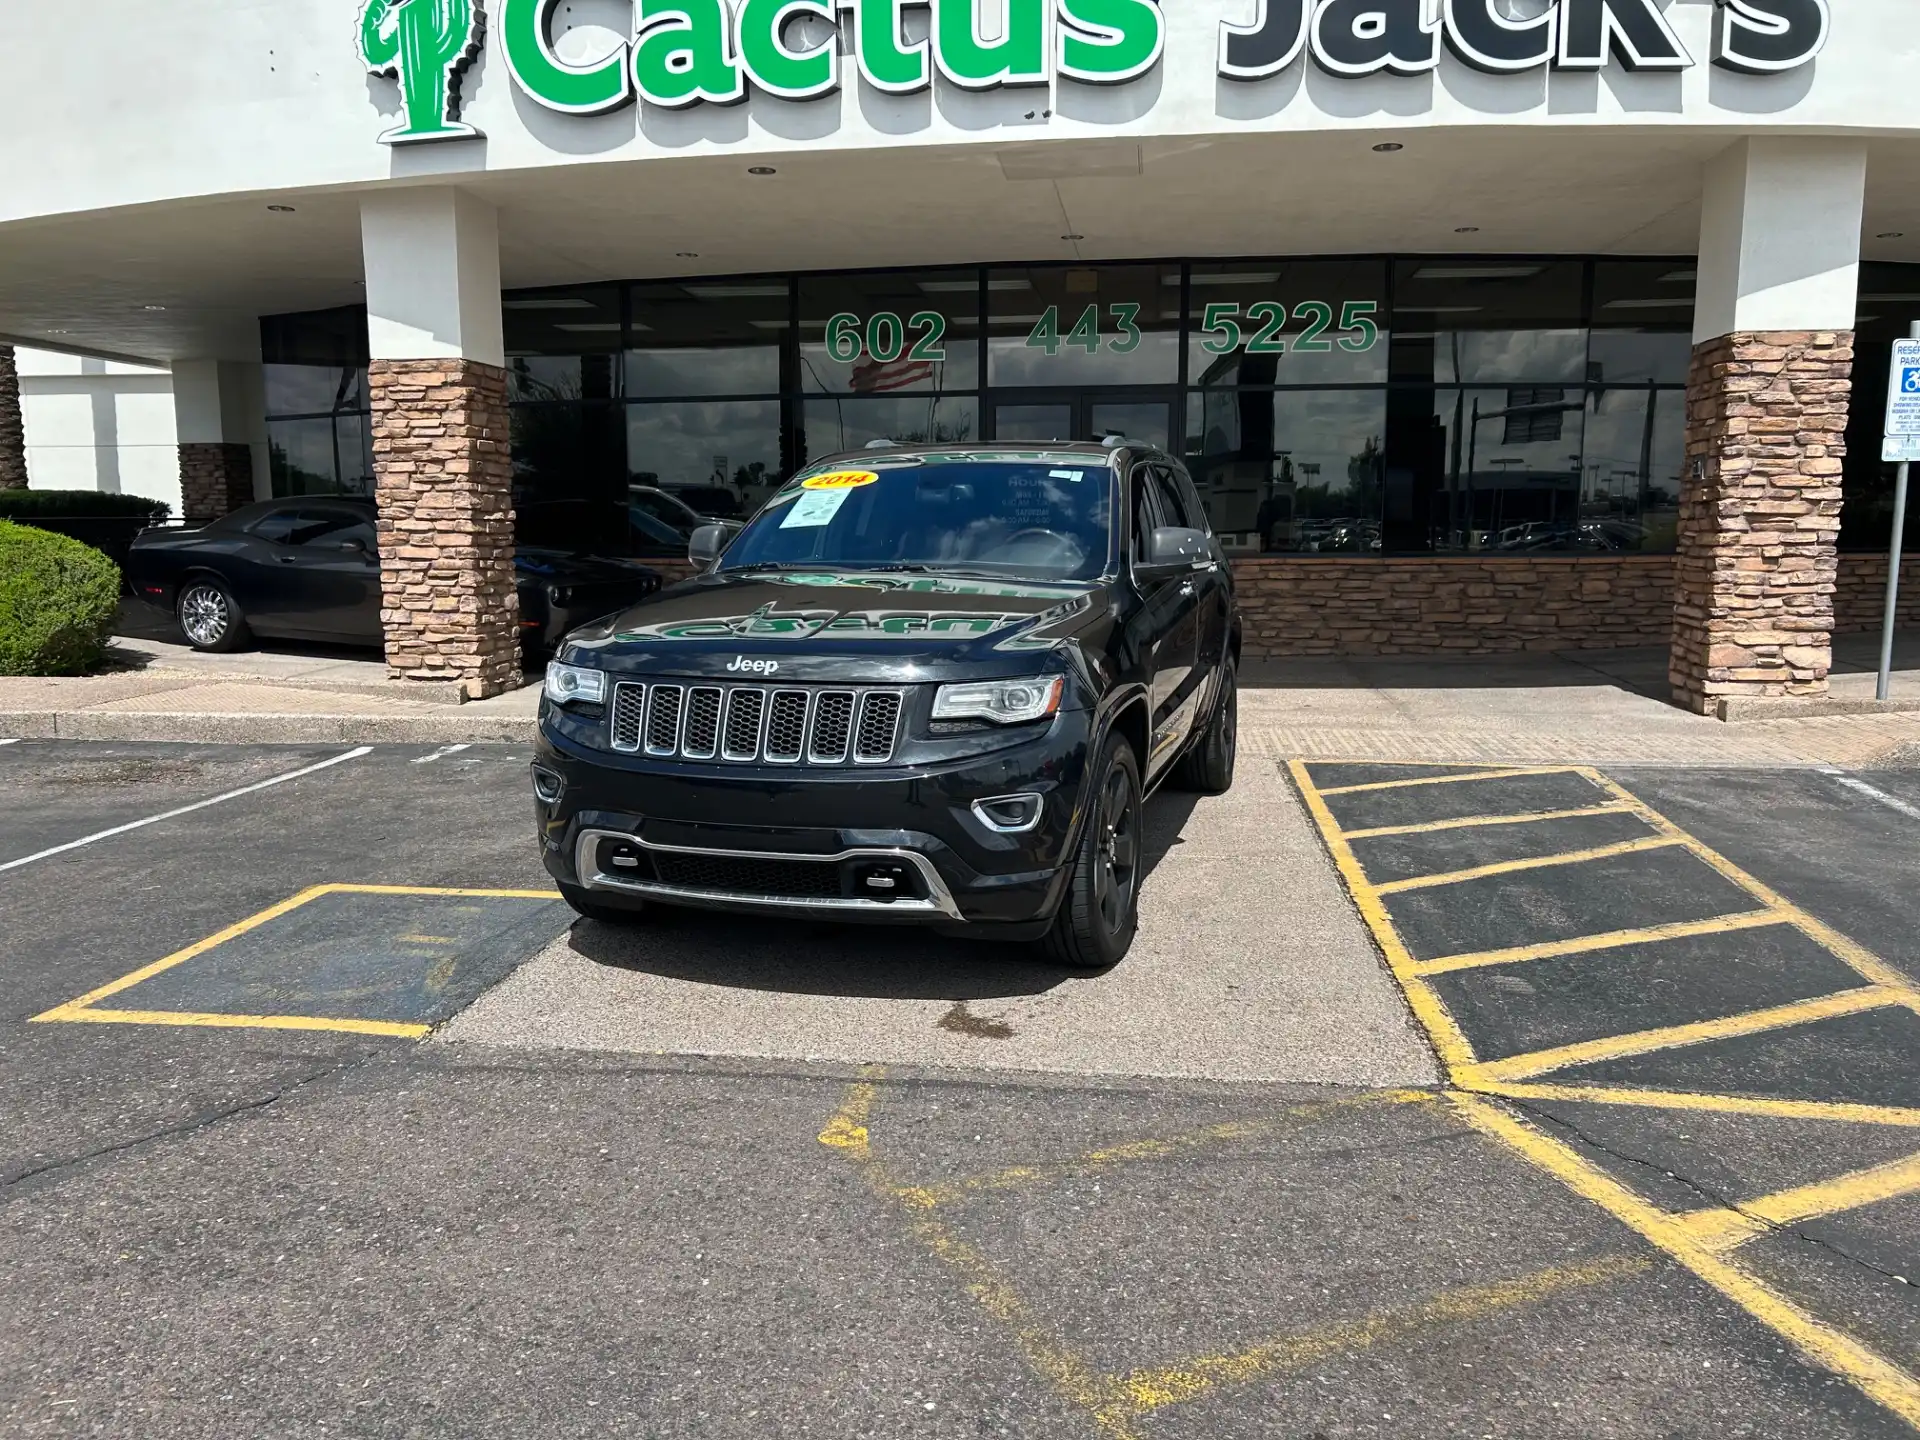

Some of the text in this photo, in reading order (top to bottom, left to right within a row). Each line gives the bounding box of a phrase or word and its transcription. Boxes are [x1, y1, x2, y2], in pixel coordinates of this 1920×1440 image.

[498, 0, 1828, 115] Cactus Jacs
[824, 300, 1378, 363] 602 443 5225
[810, 475, 872, 487] 2014
[726, 655, 779, 676] Jeep
